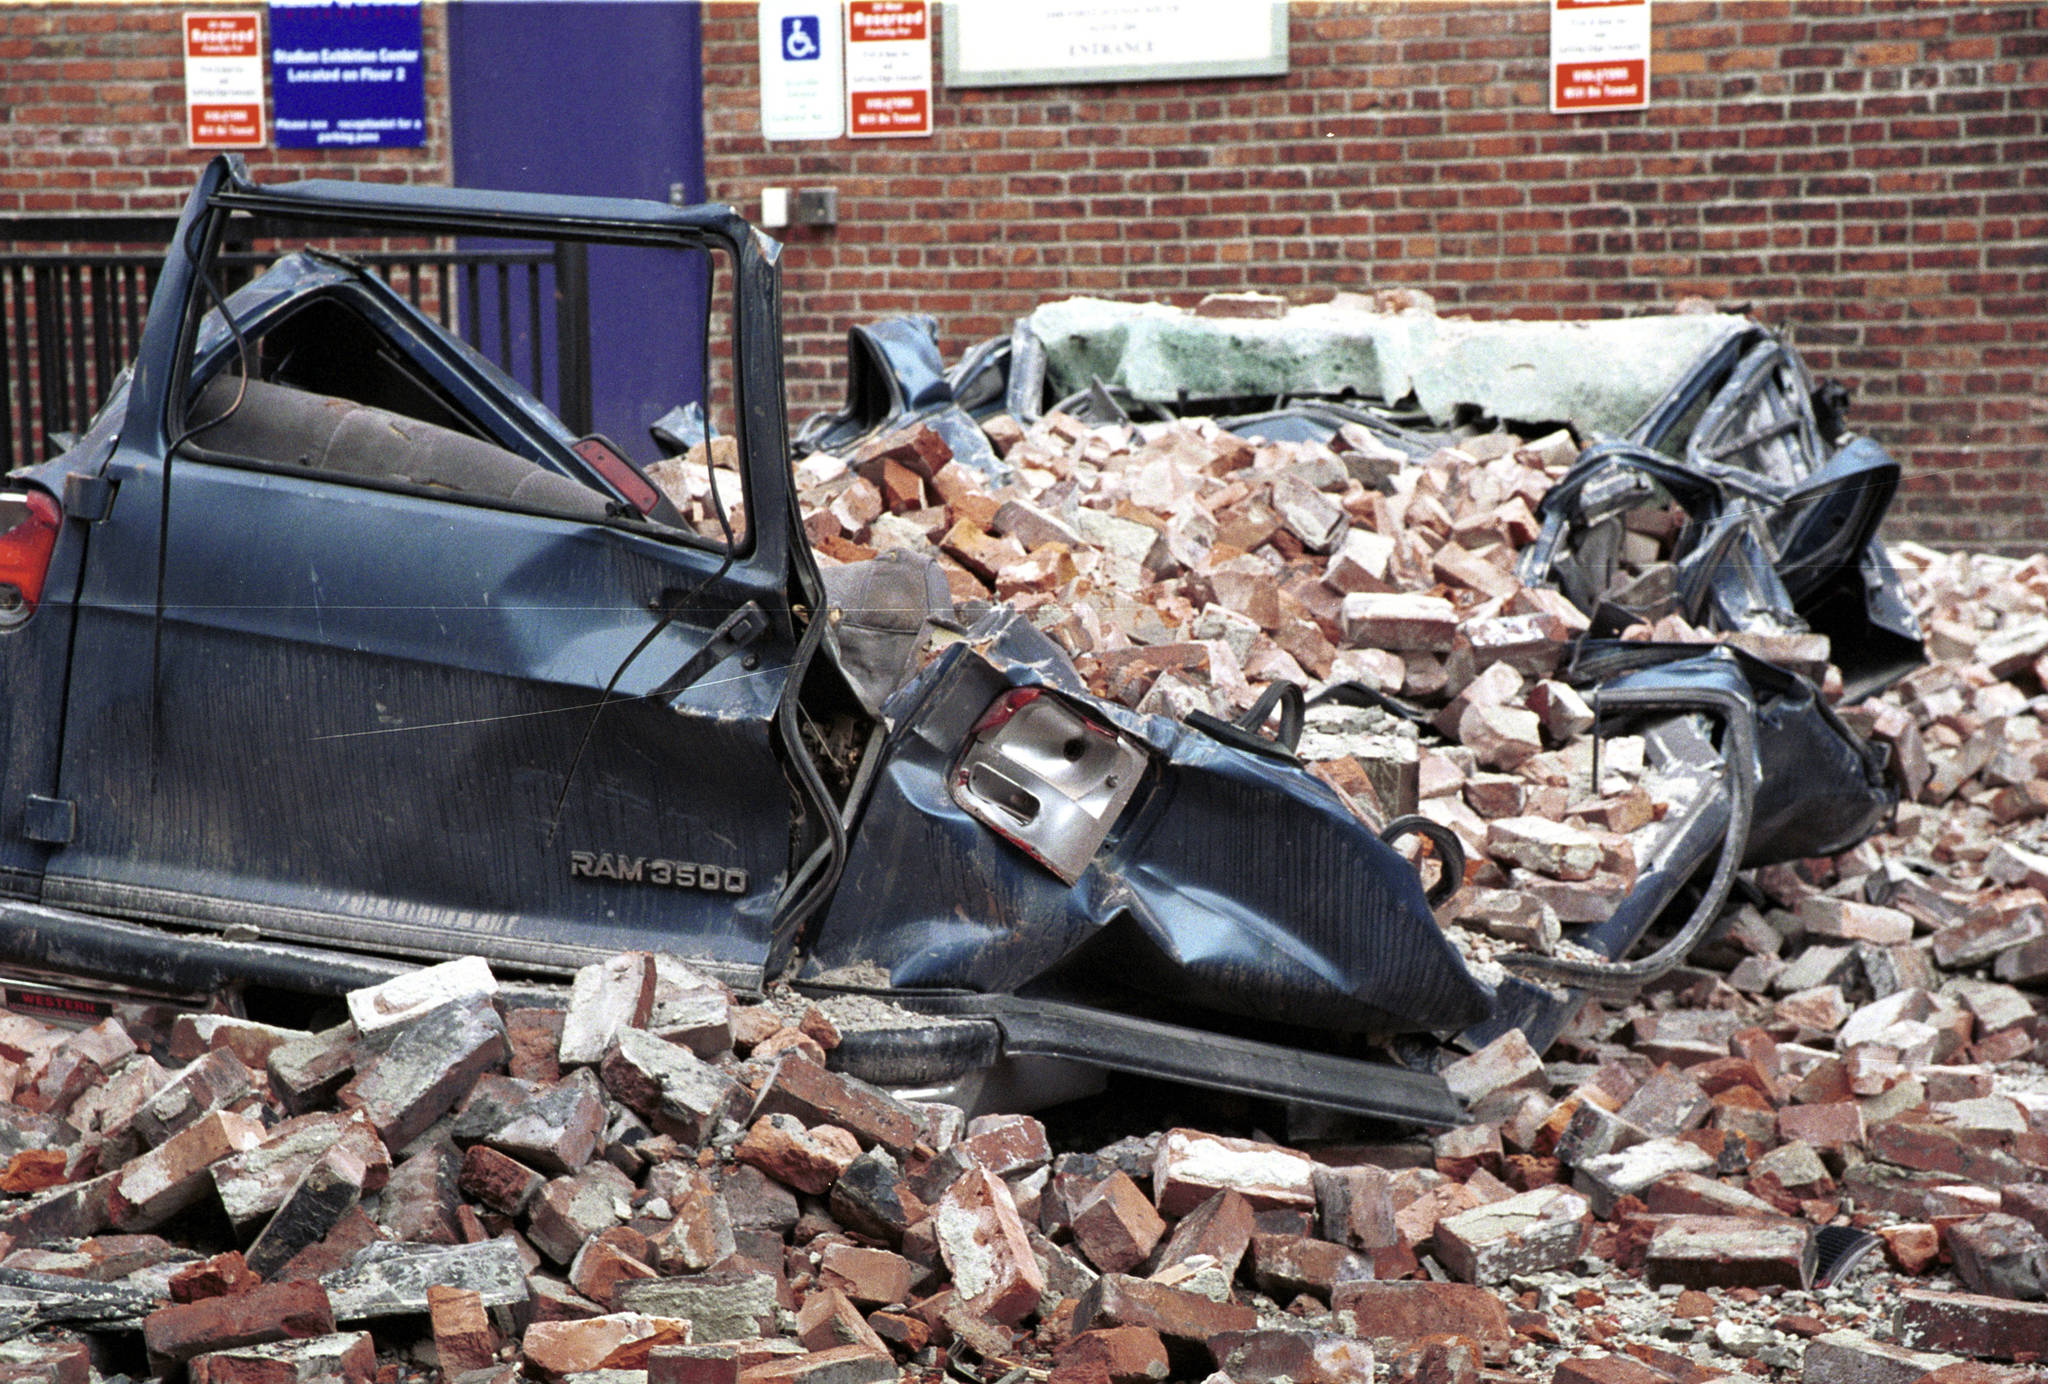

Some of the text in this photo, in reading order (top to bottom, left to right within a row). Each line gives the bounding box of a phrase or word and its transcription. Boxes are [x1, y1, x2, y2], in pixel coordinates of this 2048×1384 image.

[854, 9, 923, 27] Reserved
[191, 28, 254, 43] Reserved
[379, 47, 418, 62] Center
[287, 66, 340, 82] Located
[342, 69, 359, 82] on
[360, 66, 393, 82] Floor
[571, 850, 750, 893] RAM 3500
[21, 991, 95, 1013] WESTERN
